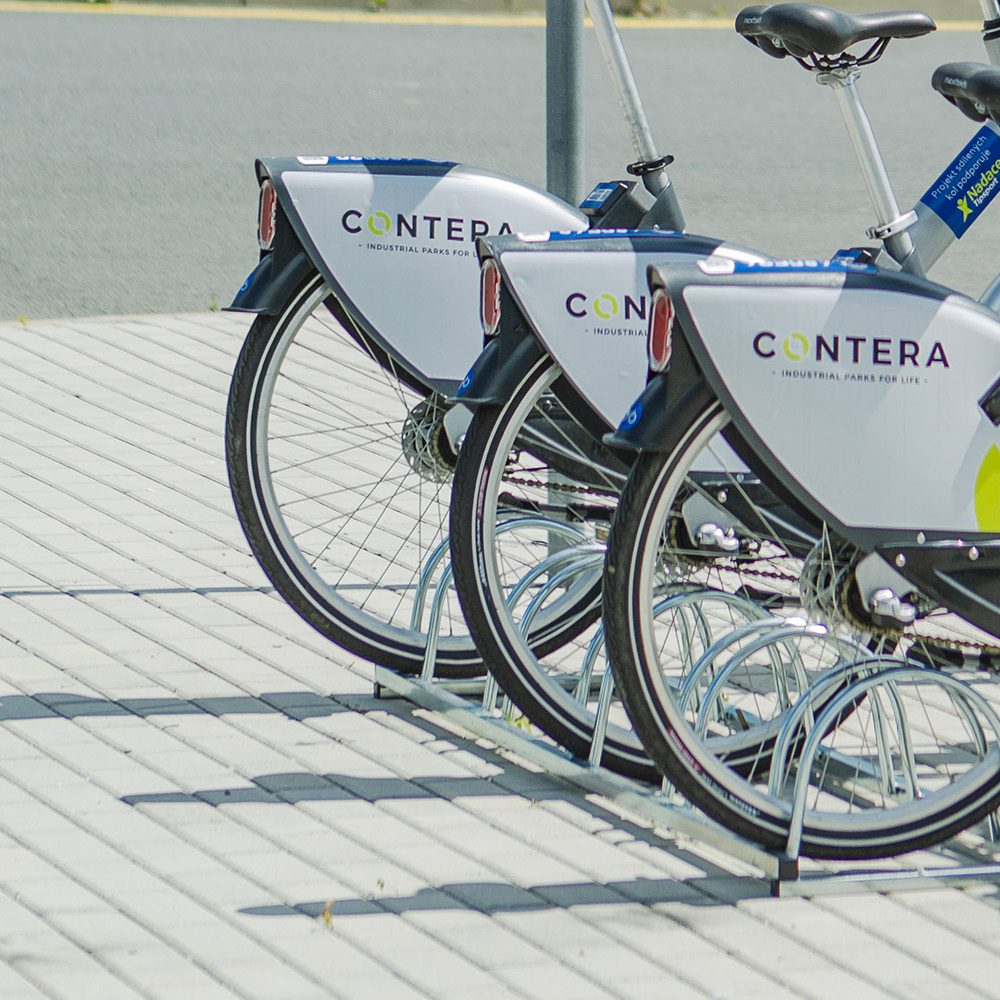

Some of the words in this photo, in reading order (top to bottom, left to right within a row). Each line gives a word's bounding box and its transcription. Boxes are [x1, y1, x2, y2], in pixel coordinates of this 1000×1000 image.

[931, 171, 958, 198] Projekt
[945, 186, 958, 200] kol
[957, 150, 990, 190] podporuje
[973, 177, 998, 207] Tipsport
[367, 243, 419, 254] INDUSTRIAL
[422, 247, 450, 256] PARKS
[453, 249, 470, 257] FOR
[593, 327, 649, 337] INDUSTRIAL
[753, 331, 950, 368] CONTERA
[781, 369, 840, 381] INDUSTRIAL
[844, 373, 876, 383] PARKS
[879, 375, 898, 384] FOR
[901, 377, 920, 385] LIFE
